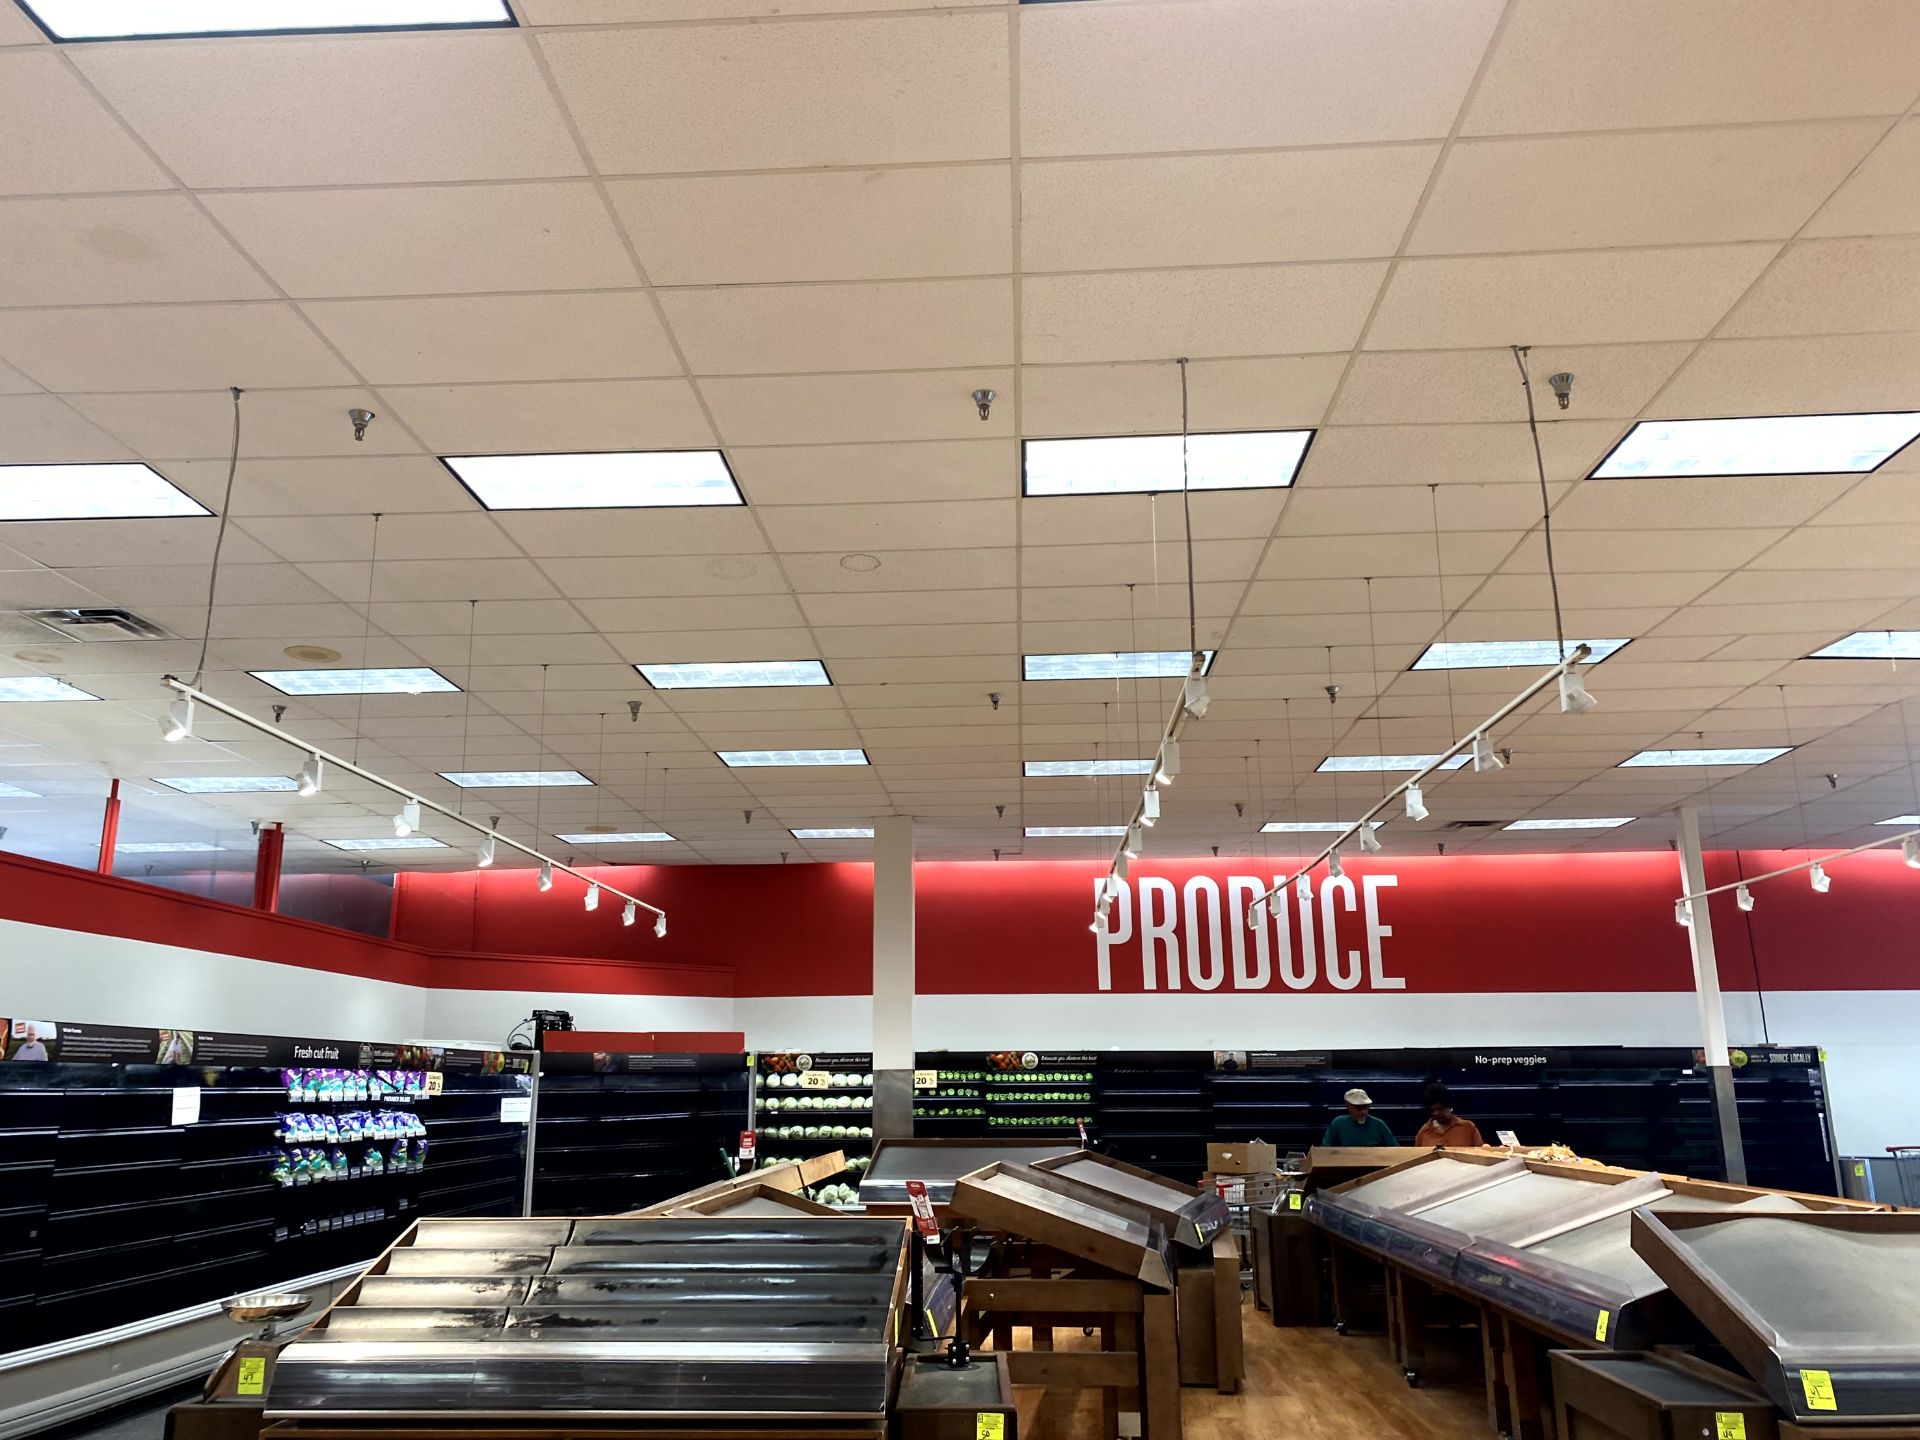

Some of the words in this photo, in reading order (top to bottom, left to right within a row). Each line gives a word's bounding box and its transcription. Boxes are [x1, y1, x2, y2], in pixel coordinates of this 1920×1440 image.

[1094, 874, 1406, 991] PRODUCE
[294, 1046, 313, 1059] Fresh
[313, 1048, 325, 1059] cut
[324, 1047, 340, 1060] fruit
[1769, 1053, 1789, 1063] SOURCE
[1790, 1053, 1811, 1063] LOCALLY
[1475, 1055, 1513, 1066] No-prep
[1513, 1054, 1547, 1066] veggies
[428, 1081, 436, 1091] 20
[807, 1078, 819, 1086] 20
[915, 1077, 927, 1085] 20
